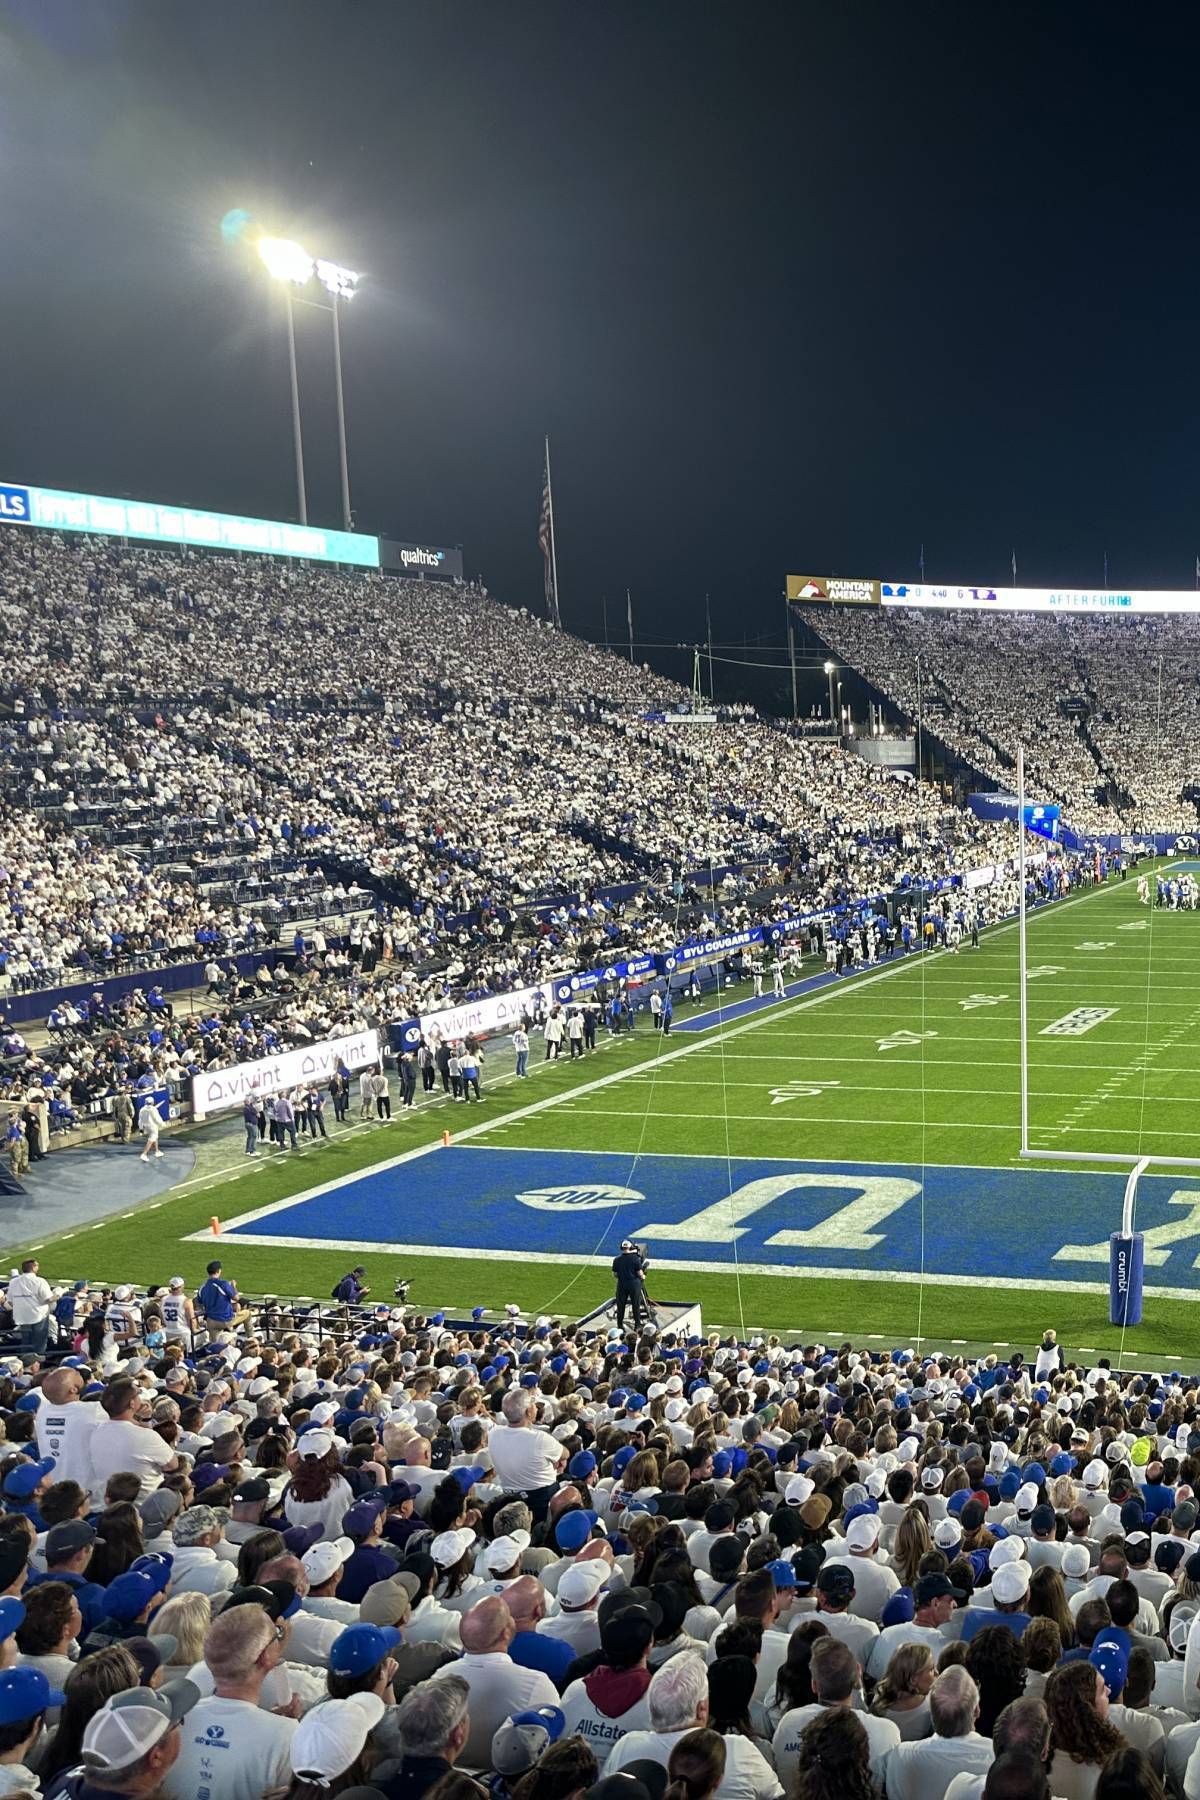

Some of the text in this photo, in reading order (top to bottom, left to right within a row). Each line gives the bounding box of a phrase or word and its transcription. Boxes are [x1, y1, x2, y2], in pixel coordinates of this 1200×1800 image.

[0, 494, 26, 517] LS
[401, 548, 437, 566] qualtrics
[826, 580, 874, 591] MOUNTAIN
[829, 590, 872, 600] AMERICA
[784, 919, 800, 931] BYU
[684, 933, 750, 959] BYU COUGARS
[444, 1009, 482, 1033] vivint
[767, 1079, 841, 1098] 10
[163, 1308, 178, 1322] 32
[574, 1718, 627, 1740] Allstate
